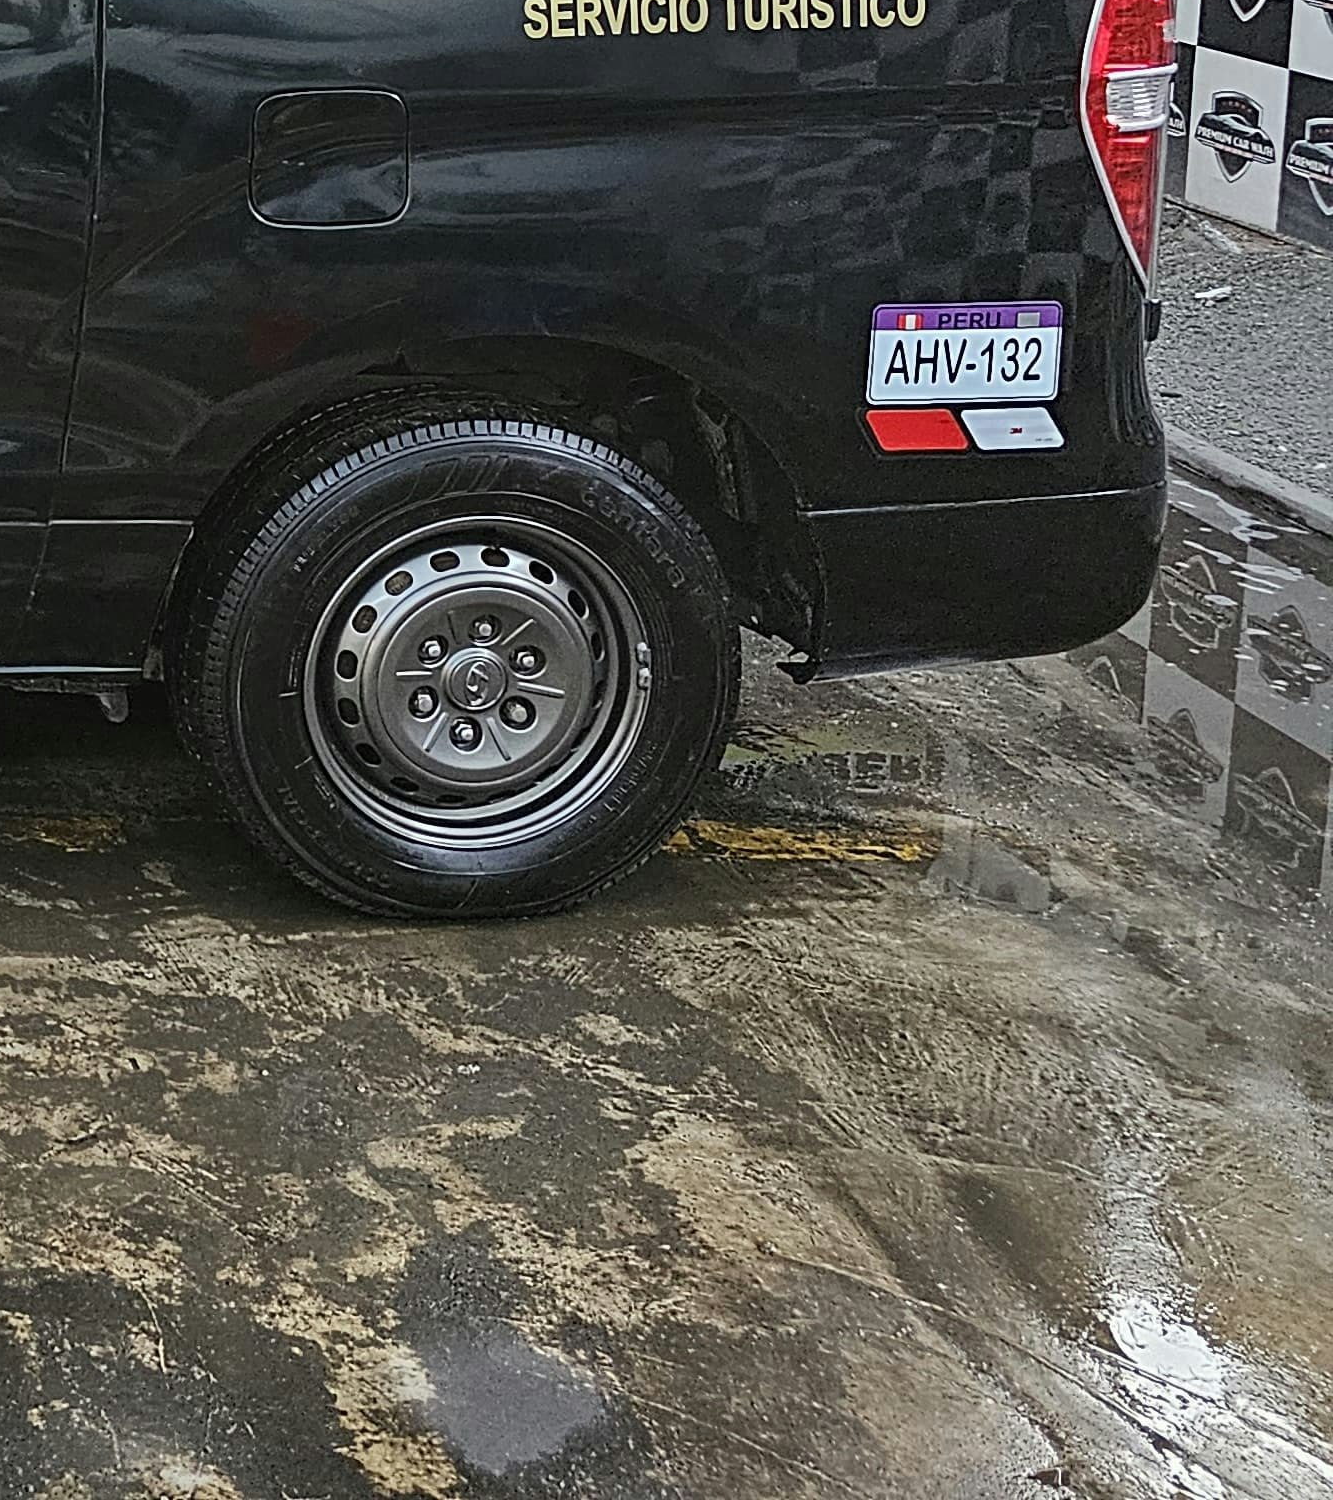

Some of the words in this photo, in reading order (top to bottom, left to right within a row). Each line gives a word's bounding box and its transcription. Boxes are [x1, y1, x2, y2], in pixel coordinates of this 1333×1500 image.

[1233, 136, 1251, 150] CAR
[937, 312, 1002, 329] PERU
[884, 337, 1043, 385] AHV-132
